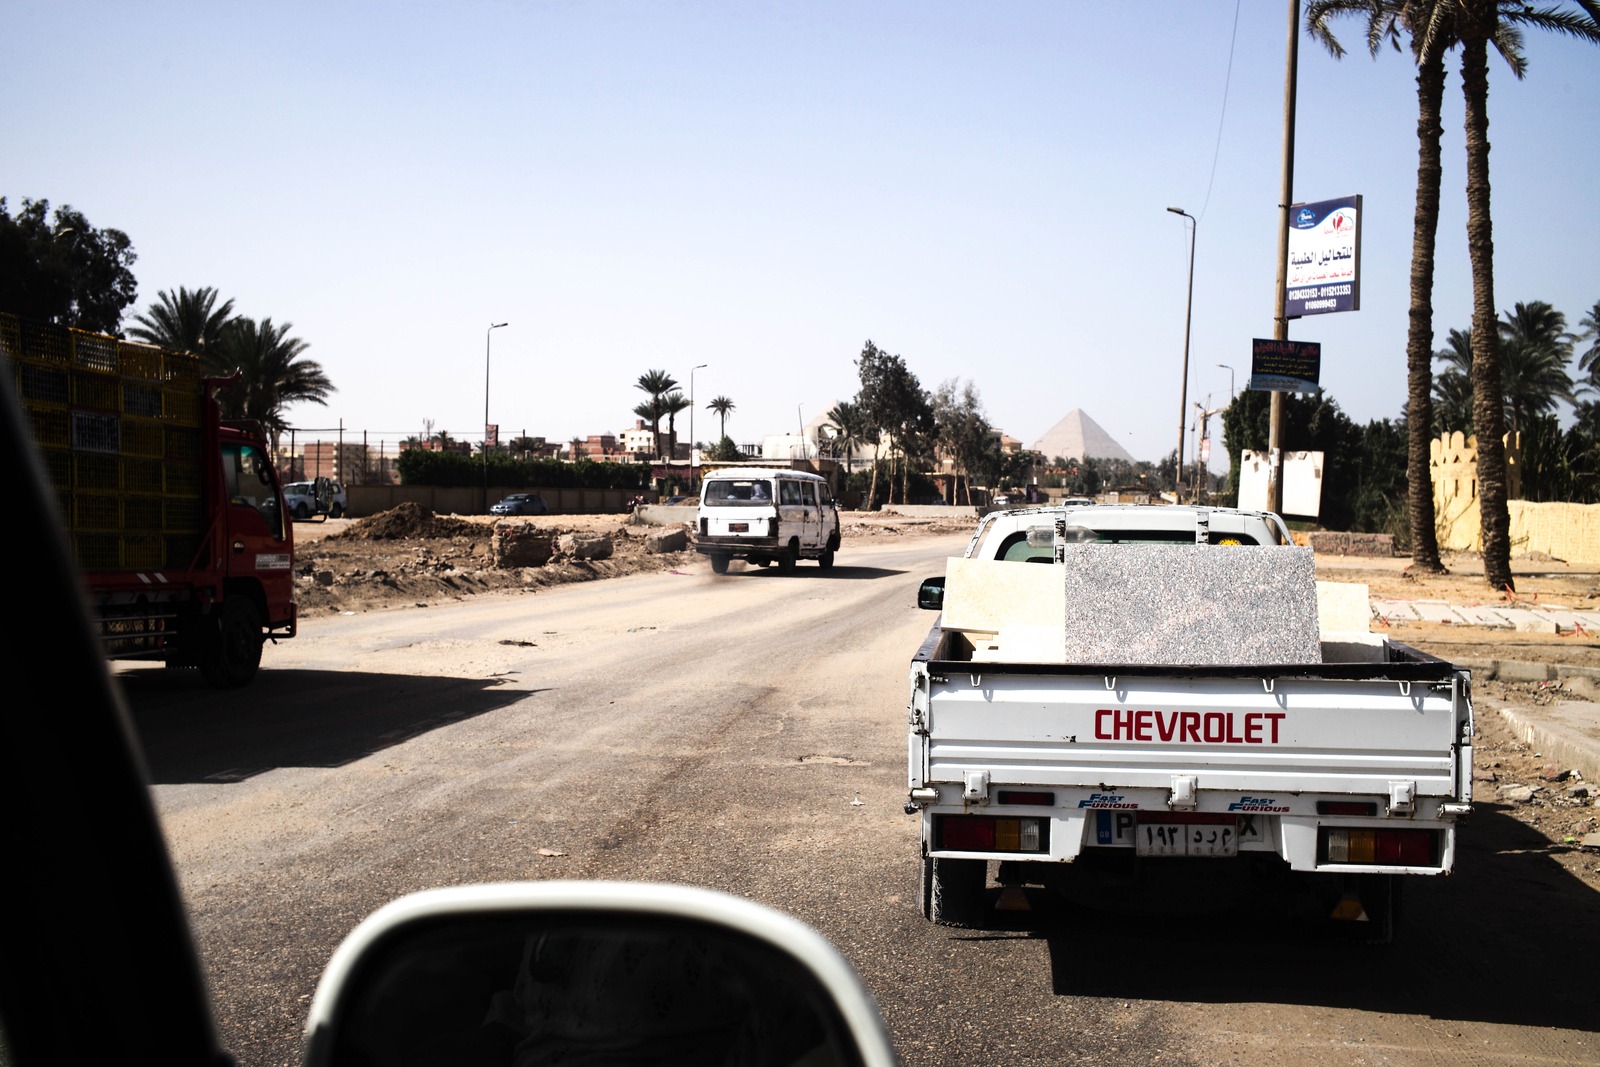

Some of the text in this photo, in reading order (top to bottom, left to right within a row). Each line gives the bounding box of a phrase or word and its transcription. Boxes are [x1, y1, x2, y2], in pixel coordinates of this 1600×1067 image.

[1291, 246, 1352, 269] للتحاليل الطبية
[1094, 709, 1286, 744] CHEVROLET
[1089, 793, 1125, 802] FAST
[1239, 796, 1276, 805] FAST
[1077, 800, 1139, 809] FURIOUS
[1227, 802, 1290, 812] FURIOUS
[1116, 813, 1133, 839] P
